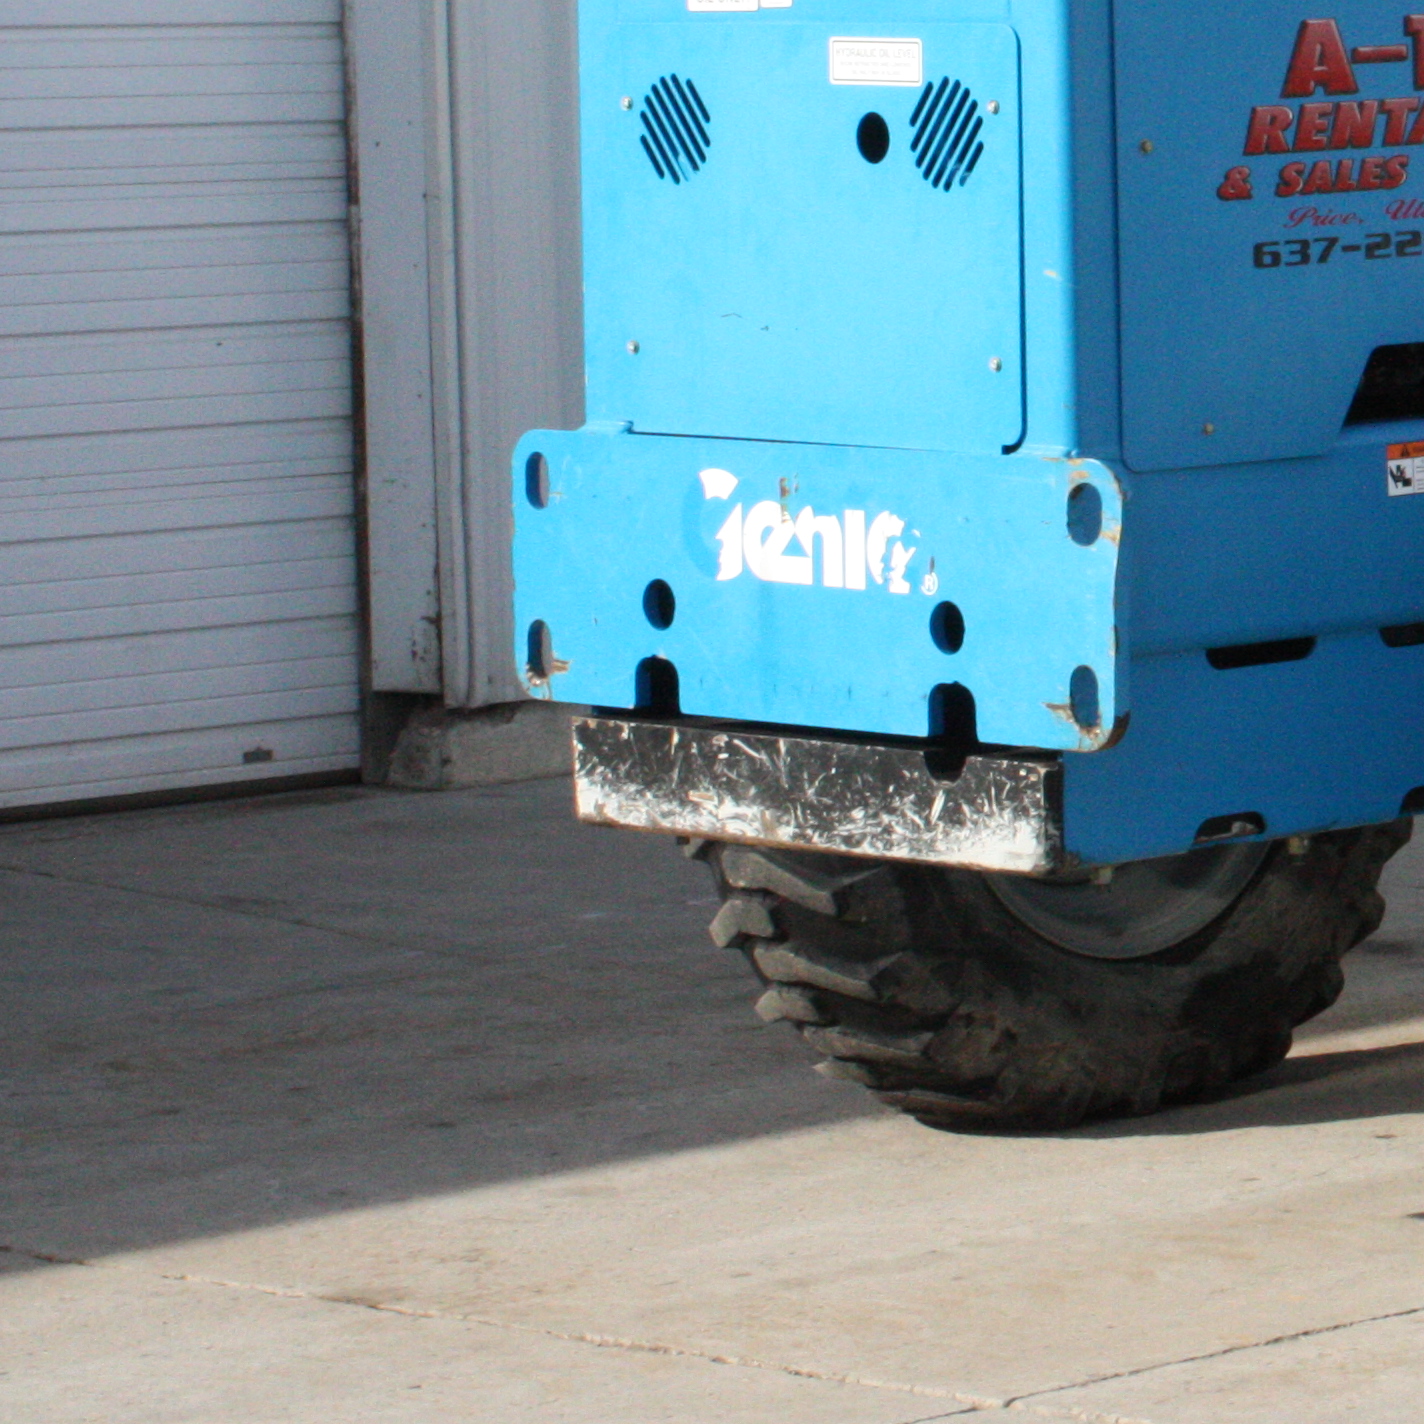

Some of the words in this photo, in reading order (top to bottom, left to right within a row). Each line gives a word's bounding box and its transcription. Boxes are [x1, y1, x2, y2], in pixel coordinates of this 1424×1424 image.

[893, 48, 917, 59] LEVEL
[1216, 165, 1253, 201] &
[1275, 154, 1409, 198] SALES
